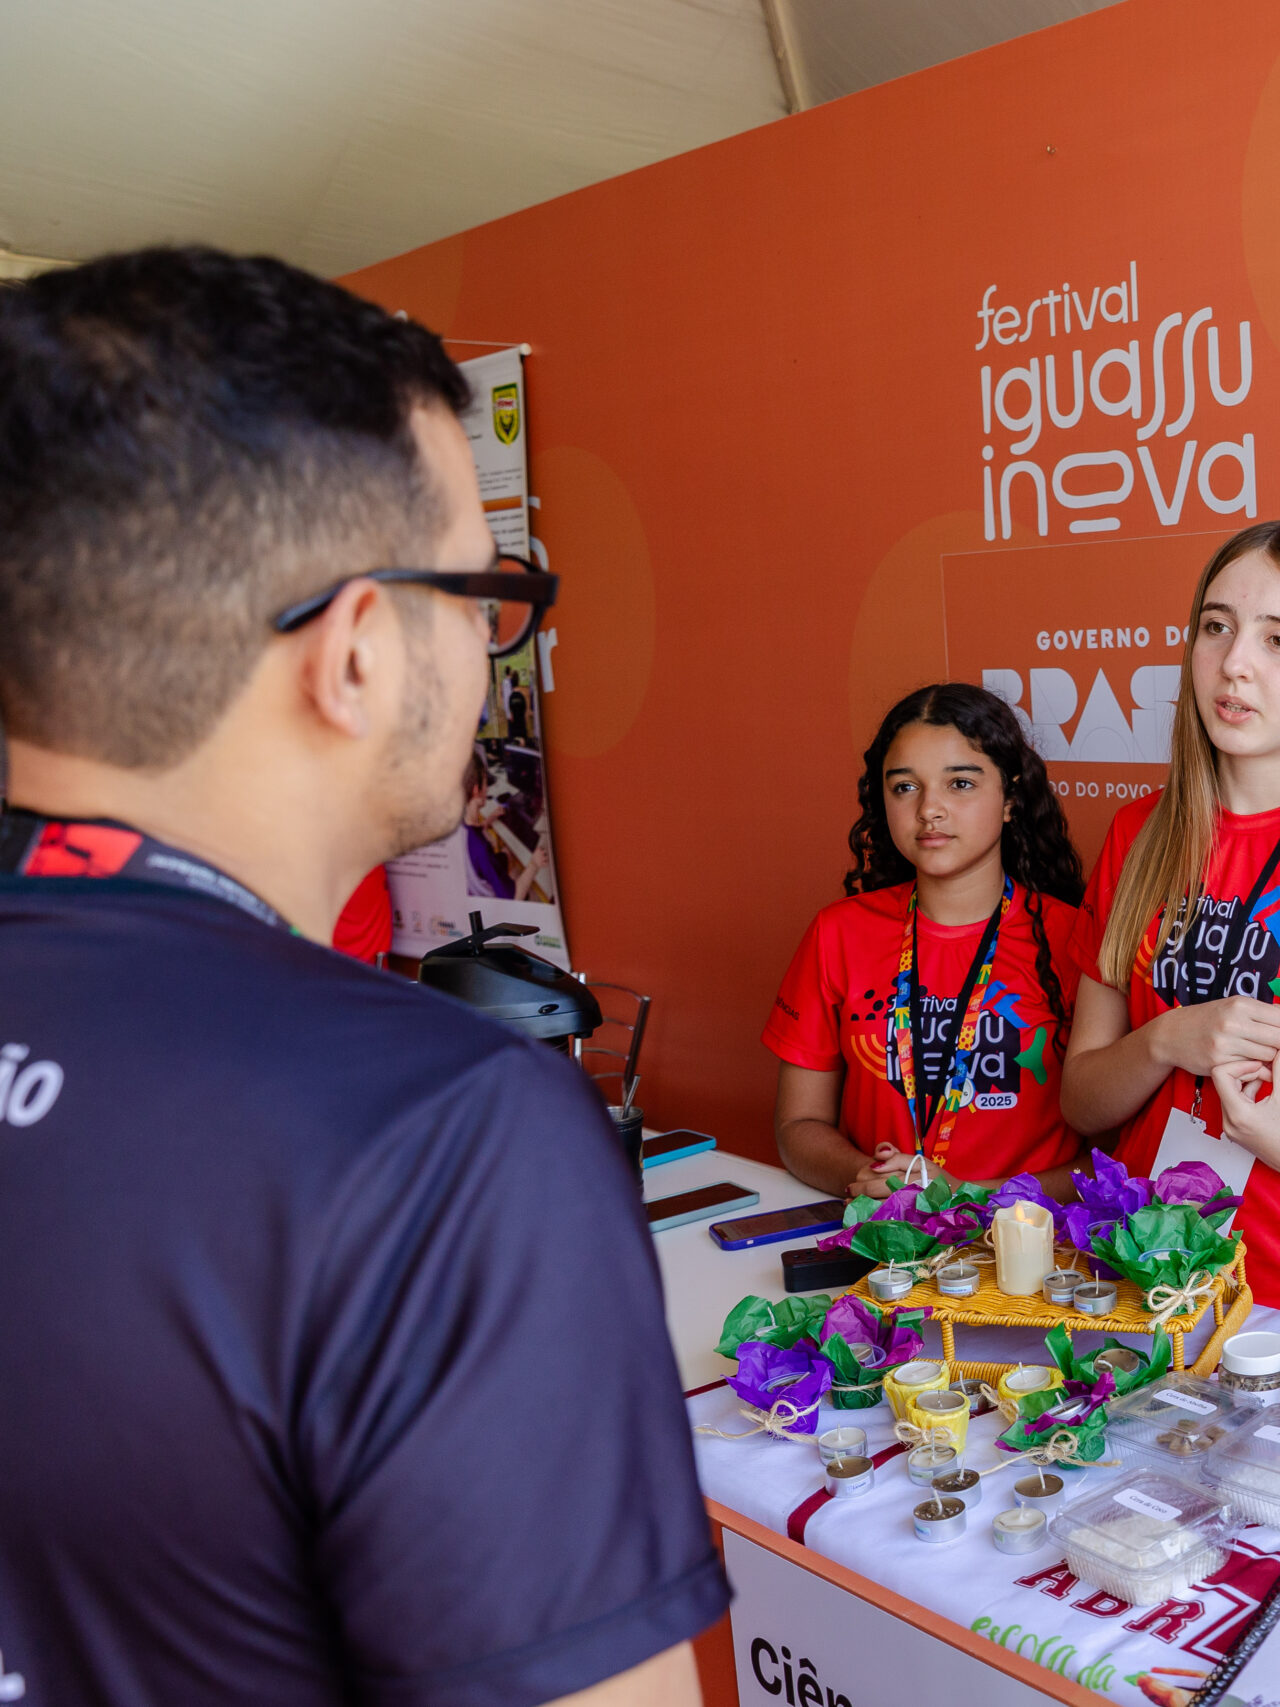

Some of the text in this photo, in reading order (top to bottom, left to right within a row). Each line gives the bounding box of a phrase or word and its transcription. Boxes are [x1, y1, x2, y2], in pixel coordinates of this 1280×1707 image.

[975, 260, 1139, 351] festival
[981, 433, 1257, 541] inova
[1036, 626, 1150, 651] GOVERNO
[1075, 781, 1099, 797] DO
[1105, 783, 1152, 799] POVO
[981, 1096, 1012, 1107] 2025
